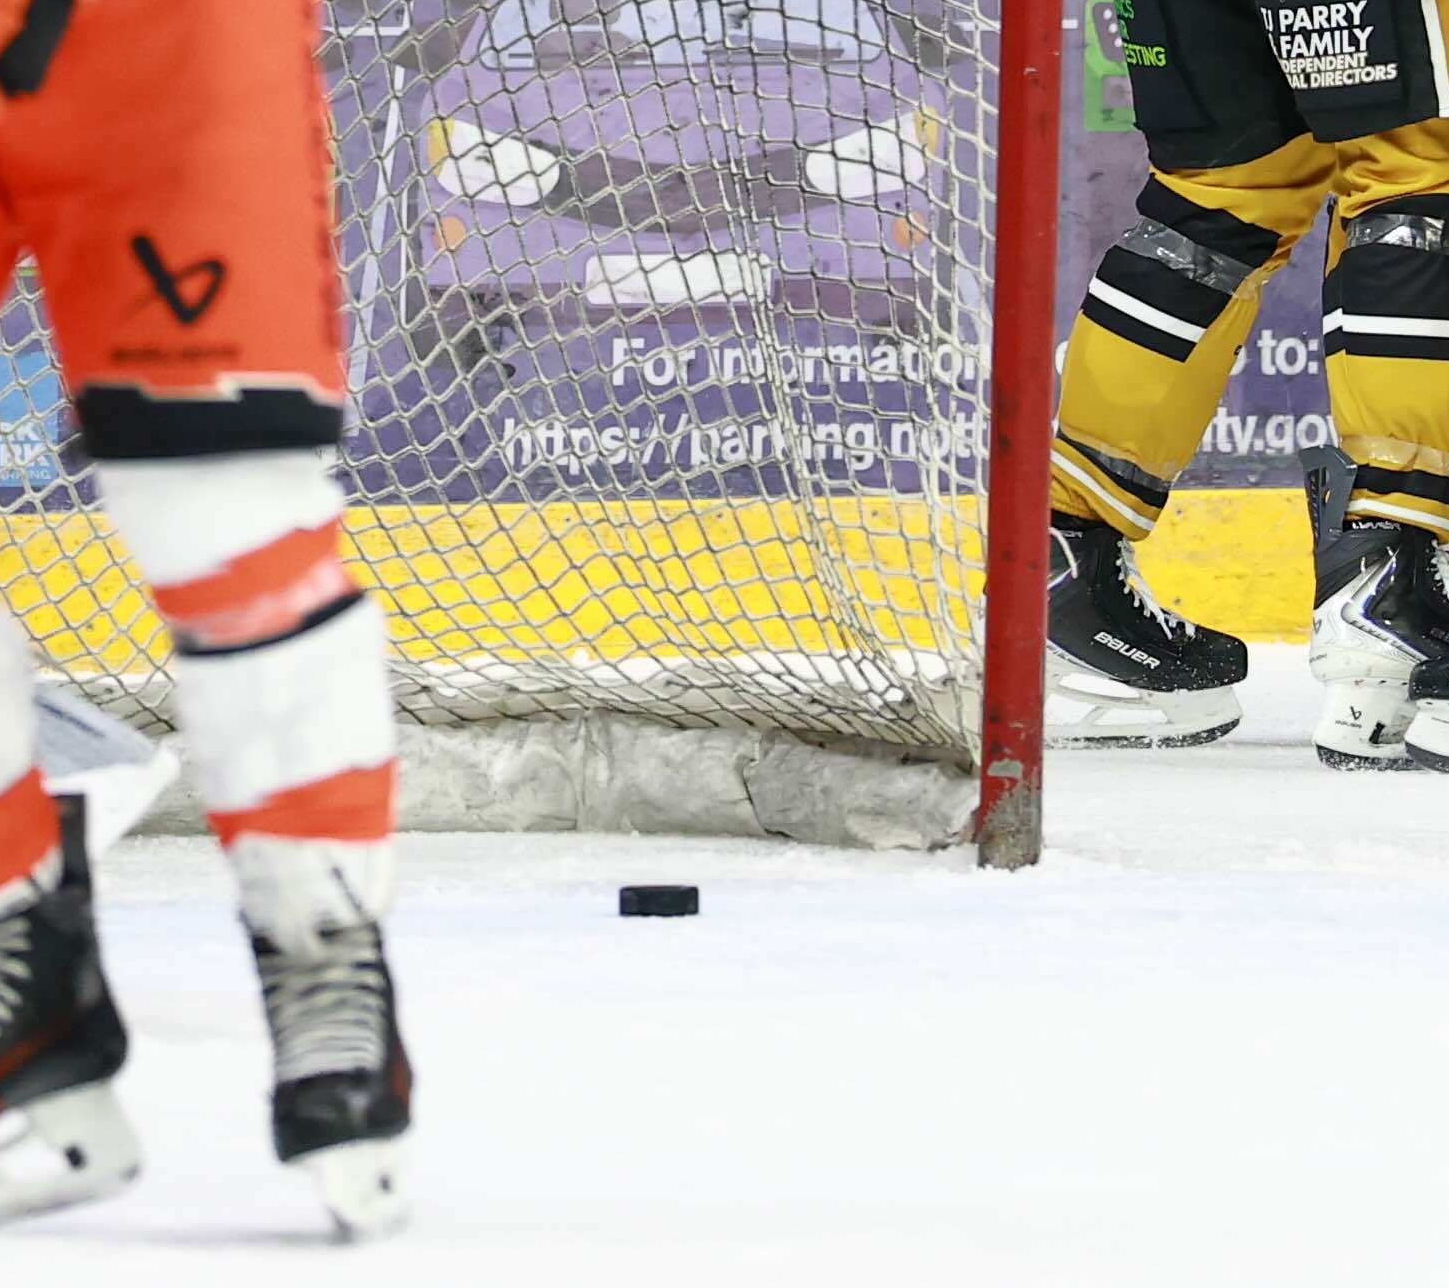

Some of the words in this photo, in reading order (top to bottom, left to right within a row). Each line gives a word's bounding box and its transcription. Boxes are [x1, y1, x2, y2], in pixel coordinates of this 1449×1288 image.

[1278, 0, 1369, 34] PARRY
[1278, 25, 1375, 59] FAMILY
[1280, 51, 1369, 75] DEPENDENT
[1310, 61, 1400, 90] DIRECTORS
[611, 337, 677, 387] For
[1257, 328, 1320, 376] to:
[1094, 630, 1162, 671] BAUER
